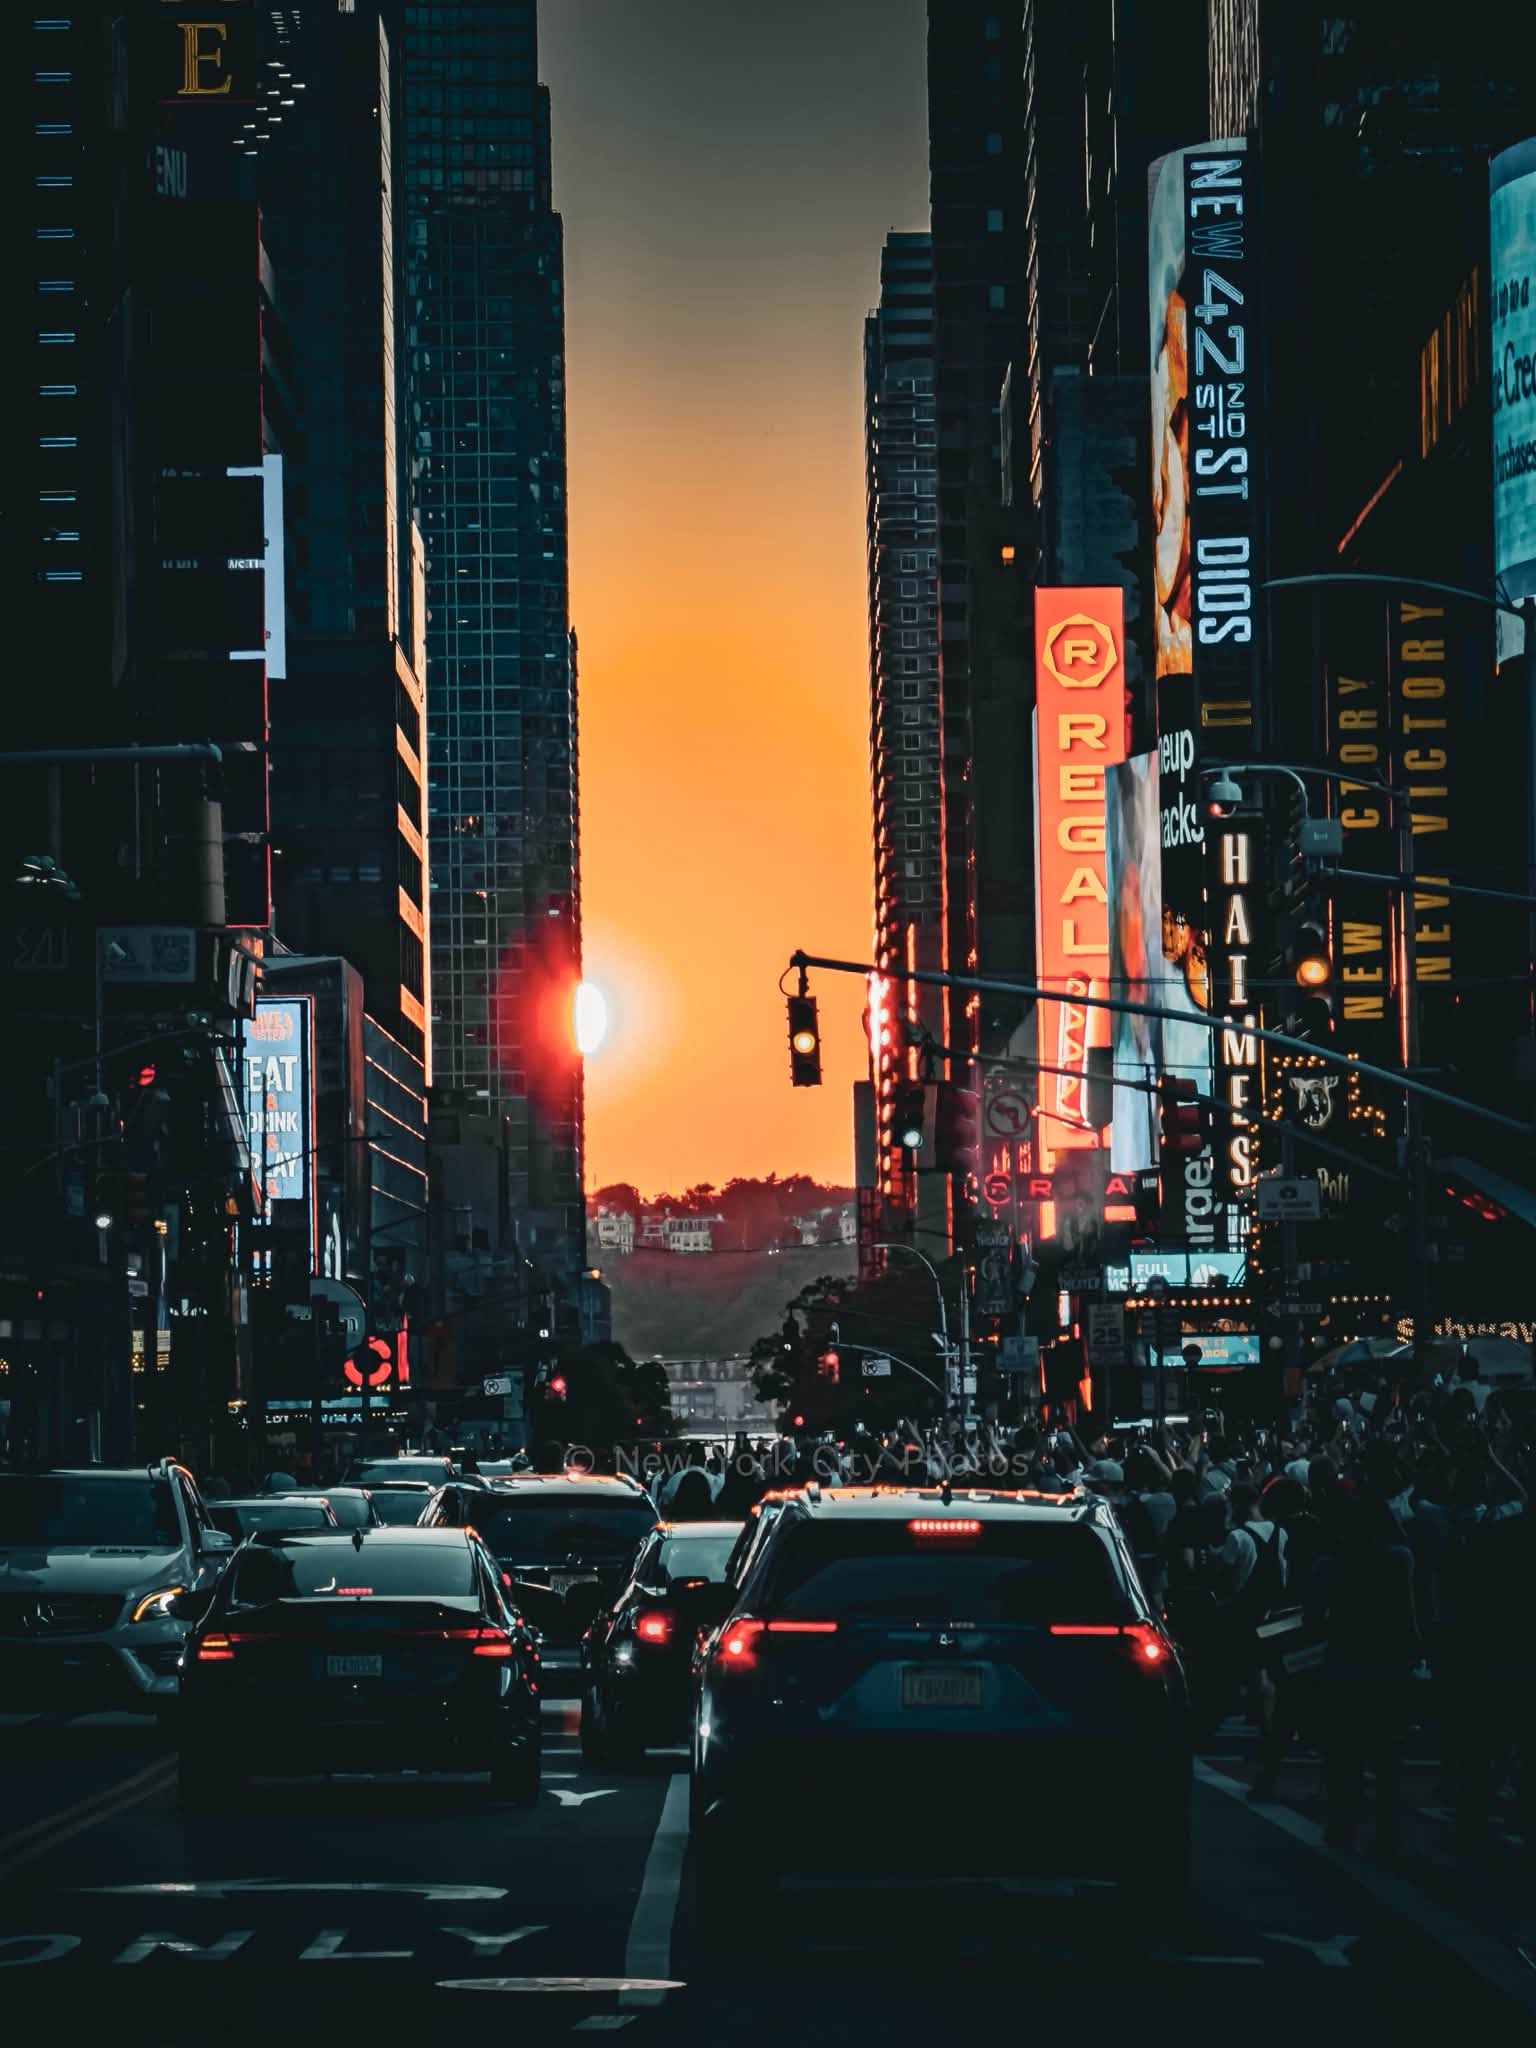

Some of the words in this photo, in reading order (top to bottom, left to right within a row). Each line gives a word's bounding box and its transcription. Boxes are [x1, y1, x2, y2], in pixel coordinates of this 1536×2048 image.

[1190, 159, 1244, 259] NEW
[1063, 639, 1098, 665] R
[1400, 601, 1449, 835] VICTORY
[1057, 713, 1109, 956] REGAL
[1160, 792, 1204, 848] acks
[1342, 921, 1386, 1020] NEW
[247, 1056, 298, 1092] EAT
[1092, 1327, 1121, 1345] 25
